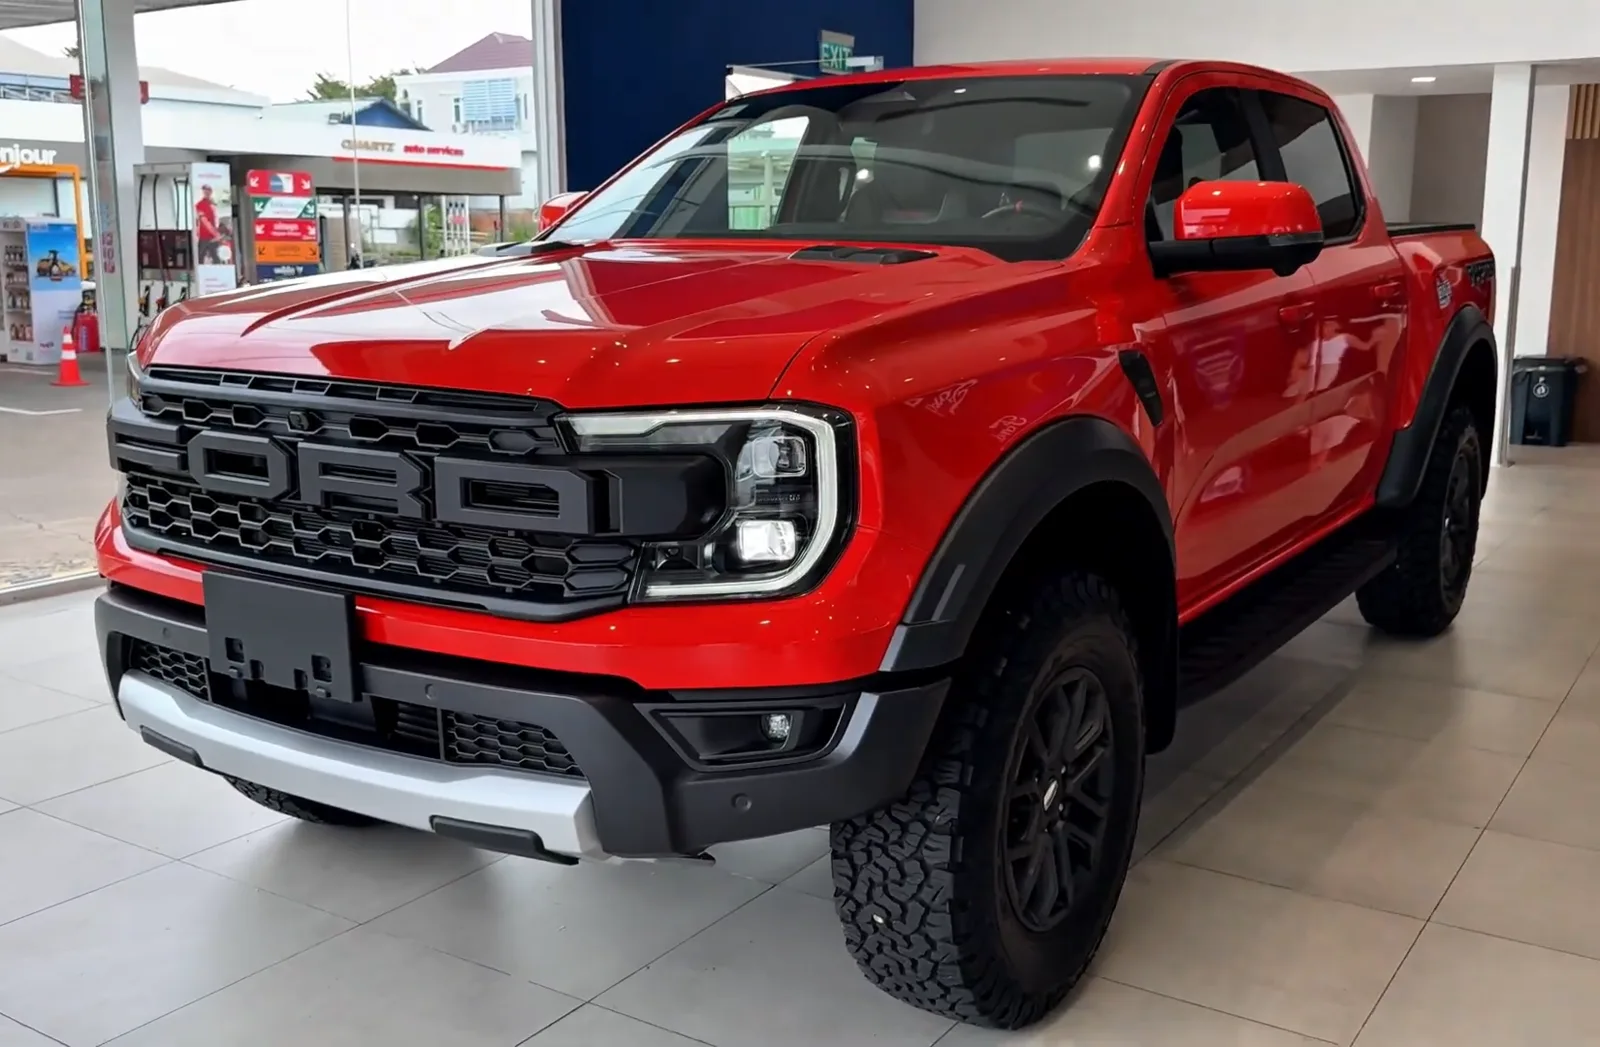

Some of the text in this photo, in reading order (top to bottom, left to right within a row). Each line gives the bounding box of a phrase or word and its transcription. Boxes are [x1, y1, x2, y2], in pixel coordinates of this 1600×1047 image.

[822, 43, 852, 71] EXIT
[403, 144, 425, 154] auto
[109, 415, 597, 535] FORD
